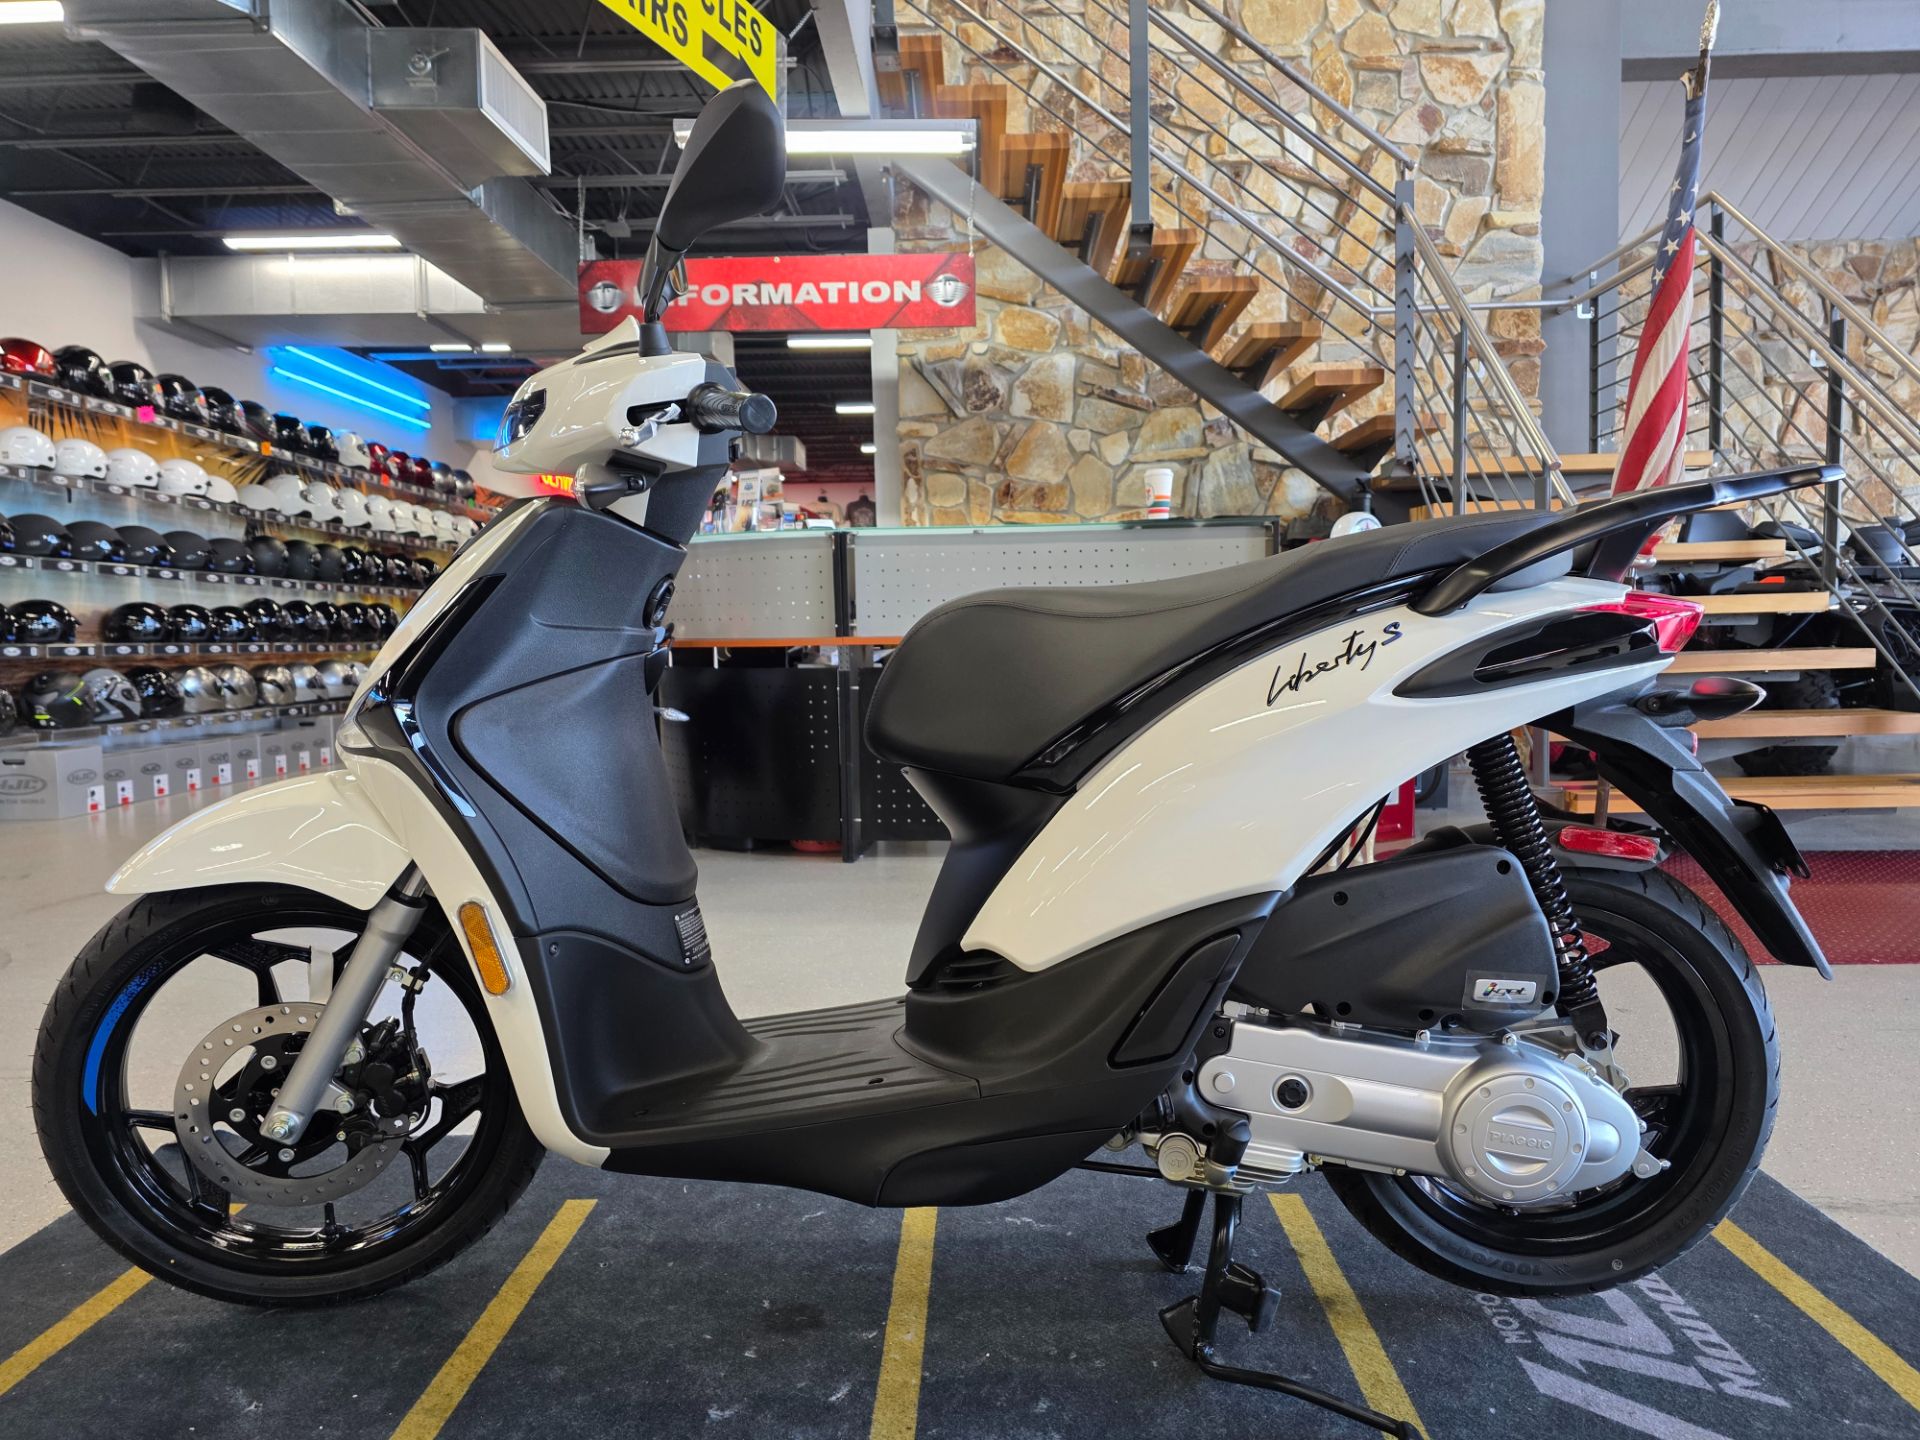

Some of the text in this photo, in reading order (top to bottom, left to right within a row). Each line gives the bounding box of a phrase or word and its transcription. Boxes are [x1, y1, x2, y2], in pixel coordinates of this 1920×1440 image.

[628, 0, 689, 47] RS
[633, 280, 922, 307] IFORMATION
[1266, 630, 1378, 707] Liberty
[1489, 1130, 1552, 1150] PIAGGIO
